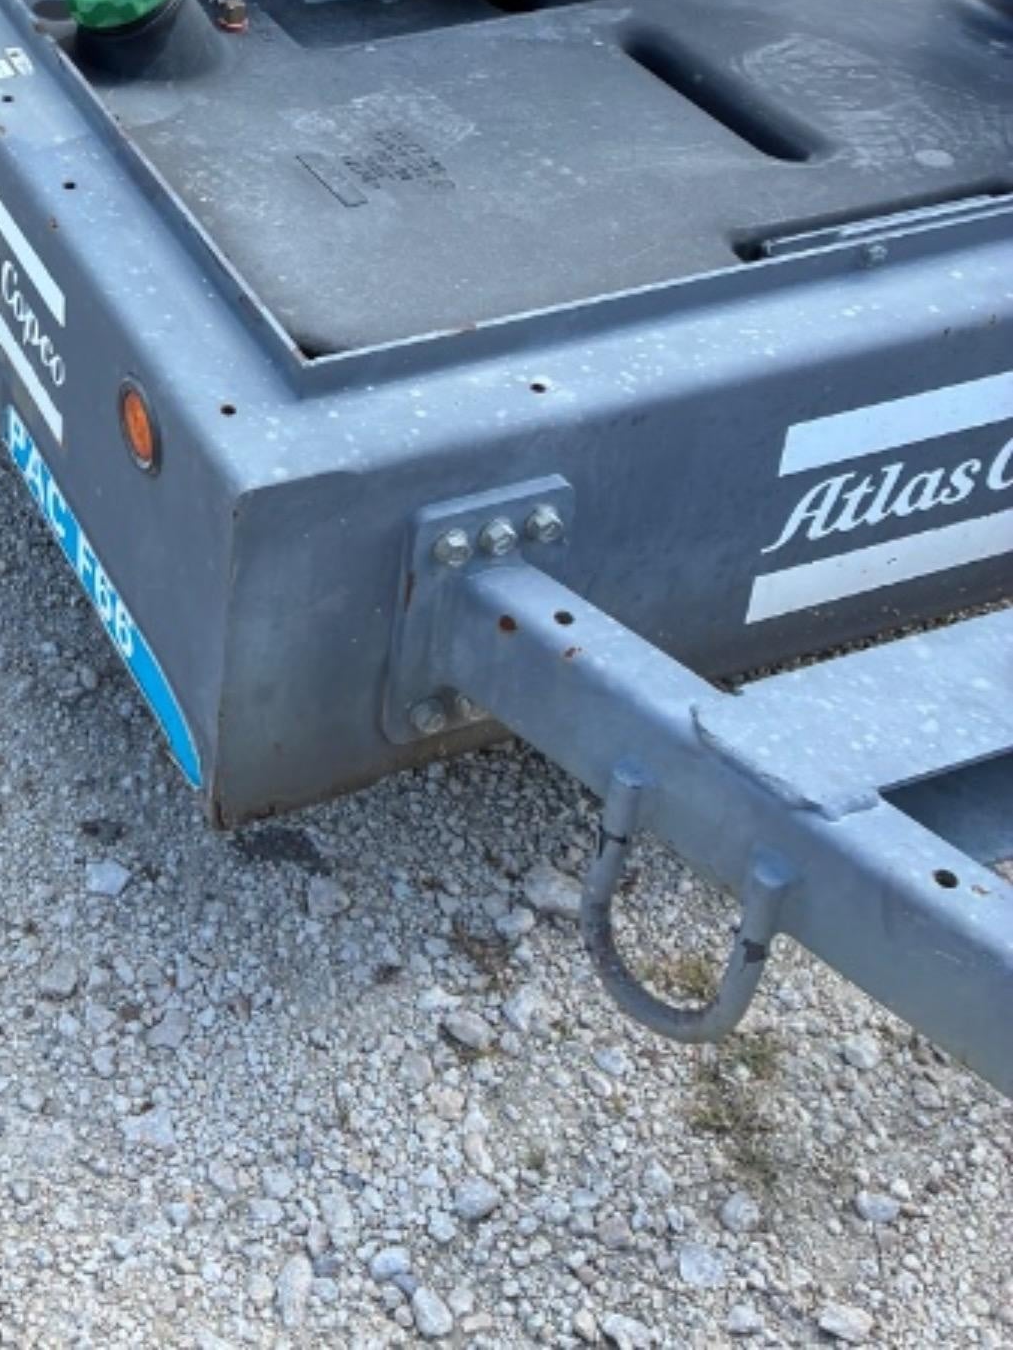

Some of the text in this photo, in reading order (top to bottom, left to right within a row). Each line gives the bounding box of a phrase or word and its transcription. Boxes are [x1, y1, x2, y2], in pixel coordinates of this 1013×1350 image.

[1, 259, 66, 386] Copco
[9, 404, 67, 538] PAC
[760, 457, 982, 555] Atlas
